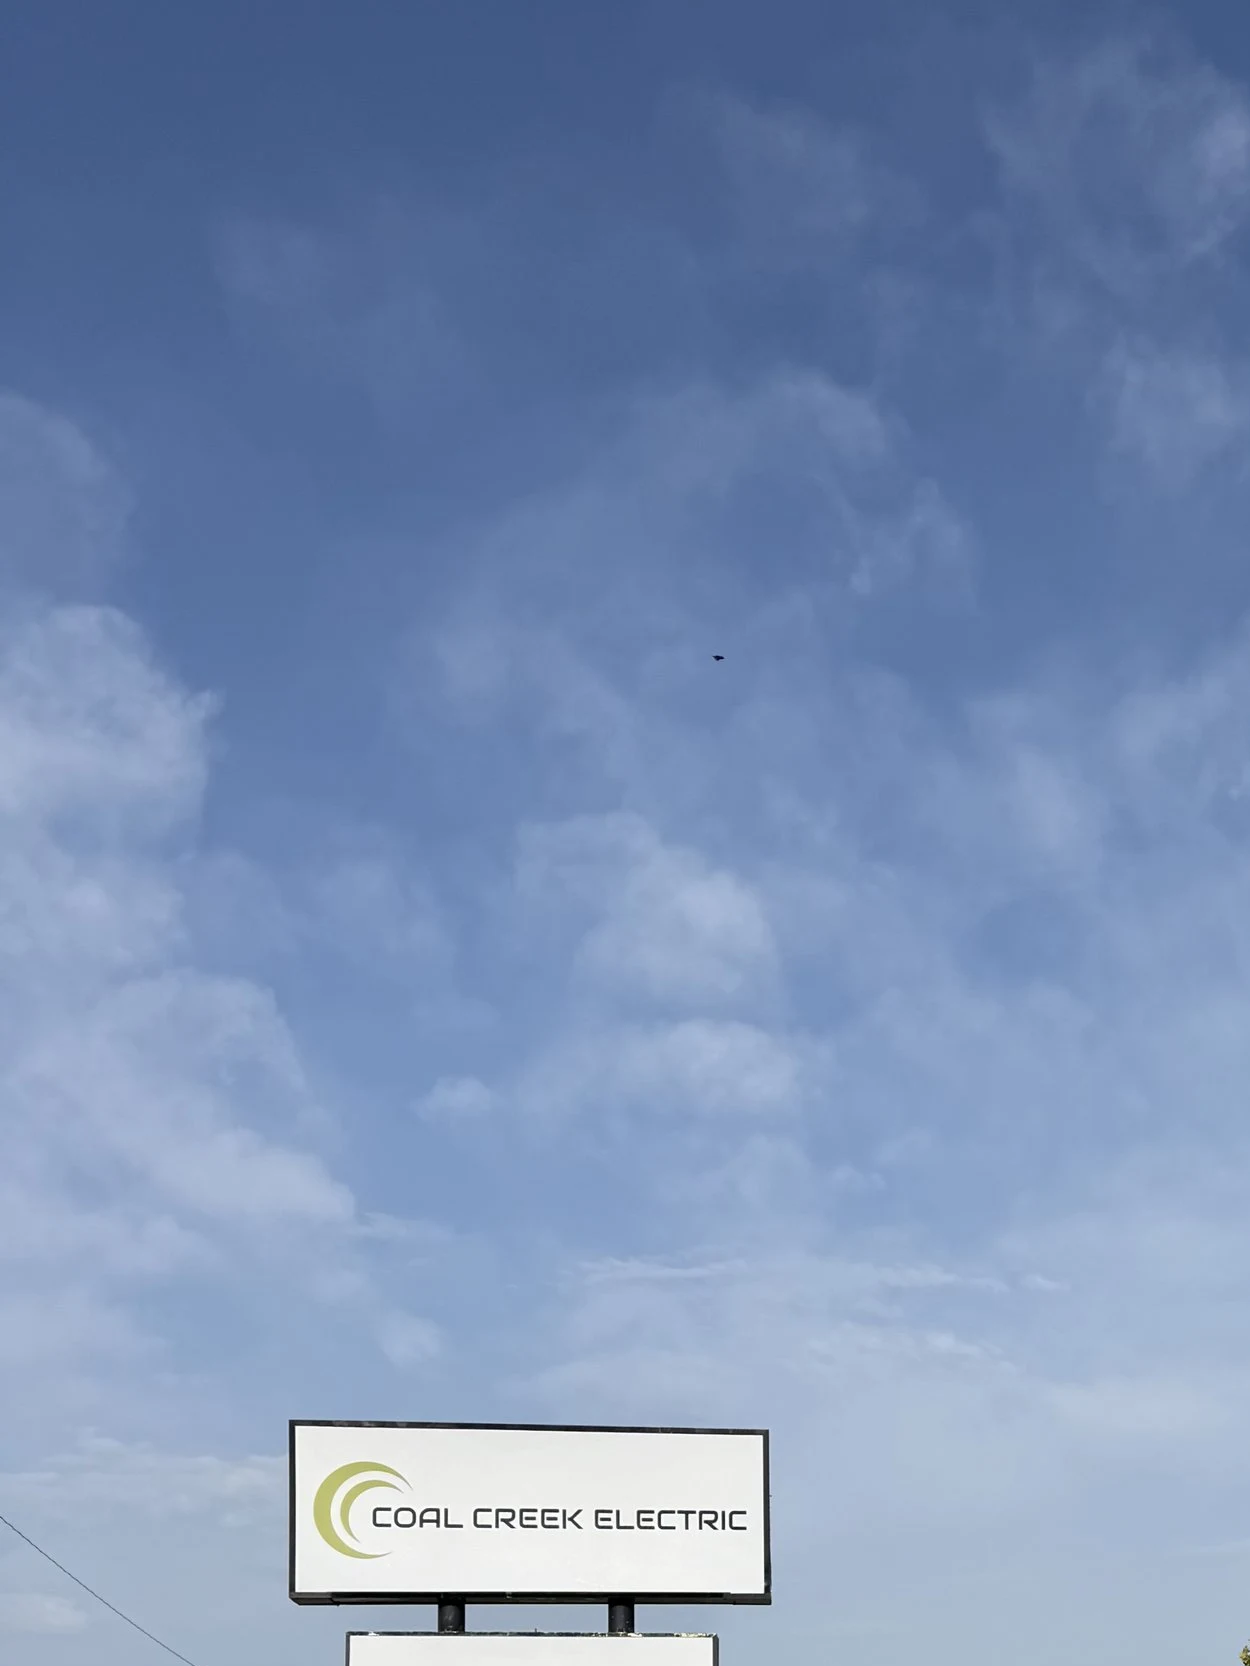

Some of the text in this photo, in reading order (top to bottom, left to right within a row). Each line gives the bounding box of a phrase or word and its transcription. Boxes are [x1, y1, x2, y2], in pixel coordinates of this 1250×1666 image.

[372, 1506, 748, 1531] COAL CREEK ELECTRIC
